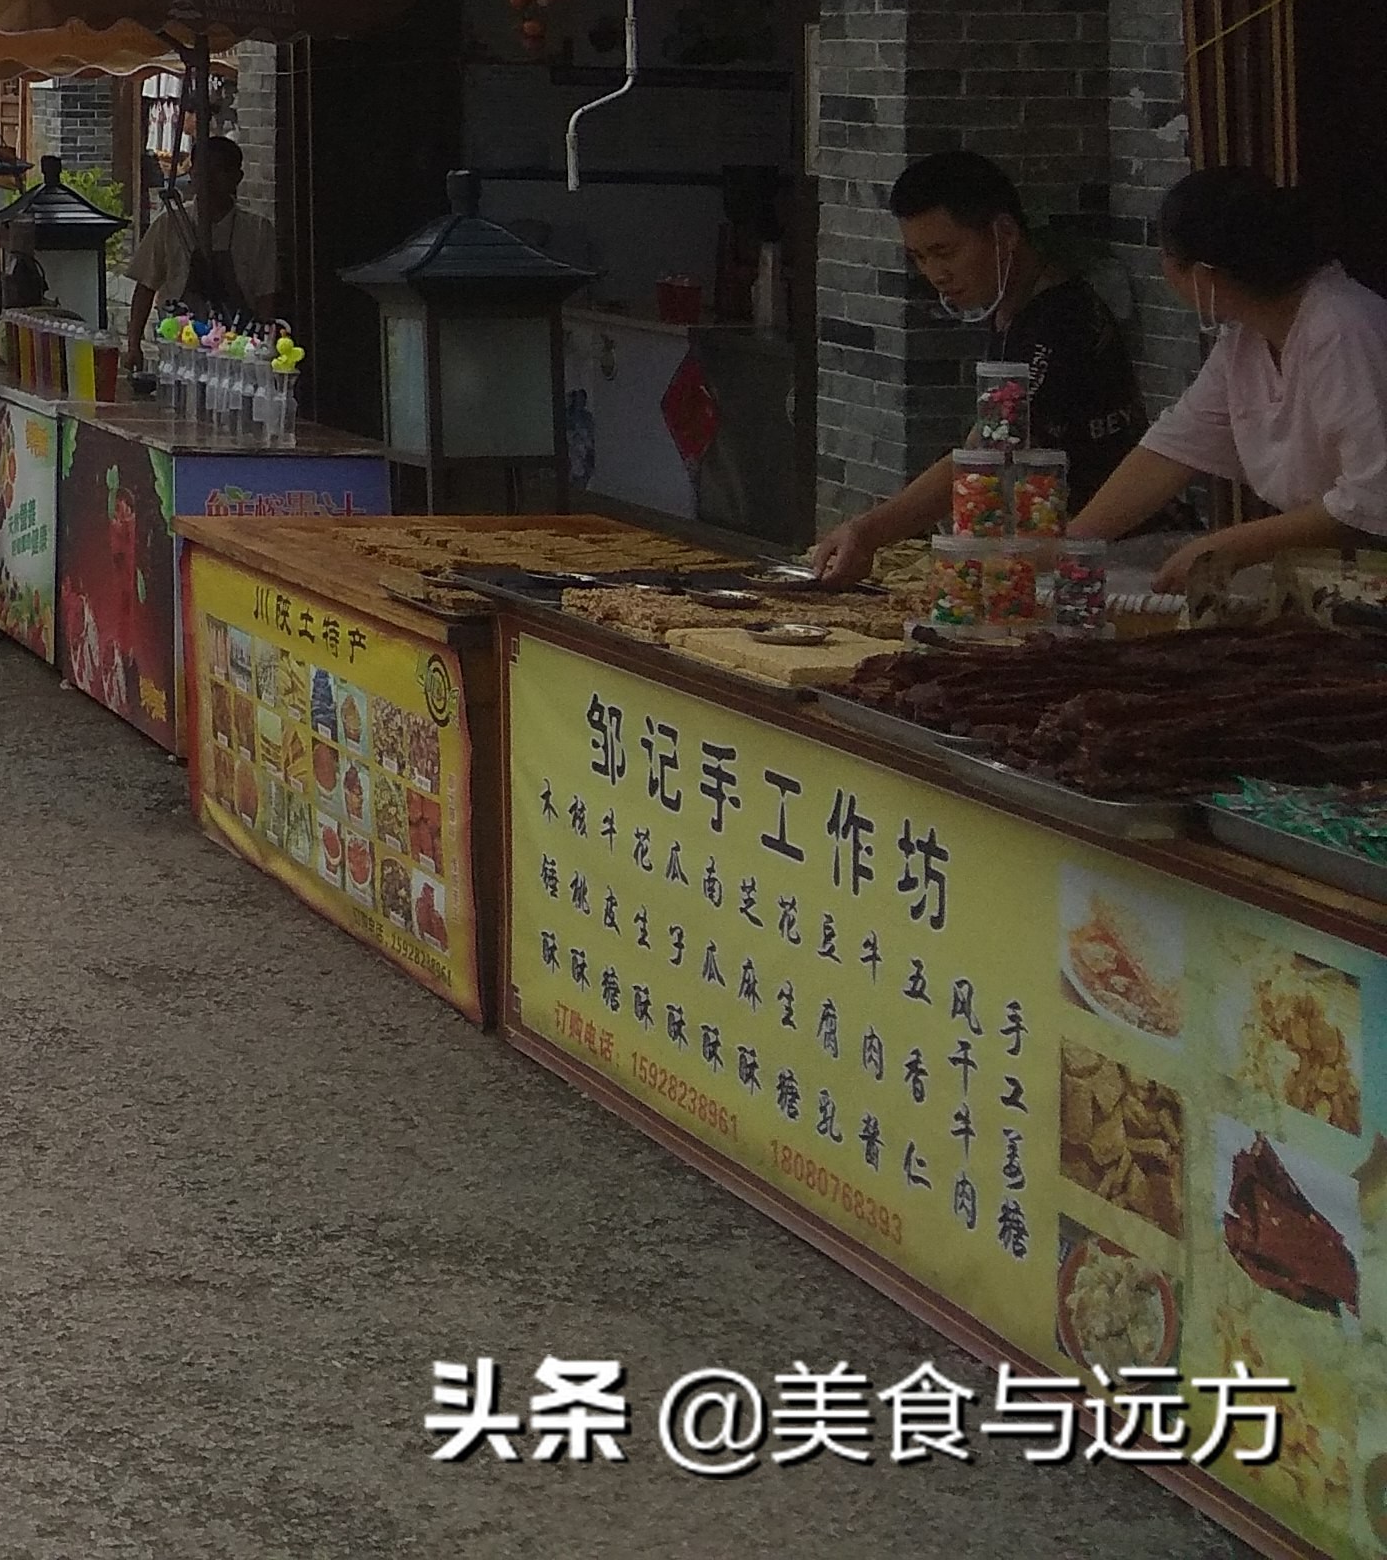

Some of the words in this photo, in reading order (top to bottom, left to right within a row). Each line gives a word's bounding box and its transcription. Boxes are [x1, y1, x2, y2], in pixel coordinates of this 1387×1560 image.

[253, 584, 367, 664] 川陕土特产
[587, 692, 951, 931] 邹记手工作坊
[600, 807, 621, 1013] 牛皮糖
[631, 826, 655, 1032] 花生酥
[665, 841, 689, 1053] 瓜子酥
[701, 855, 726, 1074] 南瓜酥
[737, 876, 764, 1097] 芝麻酥
[777, 896, 802, 1121] 花生糖
[817, 914, 843, 1144] 豆腐乳
[903, 958, 932, 1190] 五香仁
[948, 978, 984, 1231] 风干牛肉
